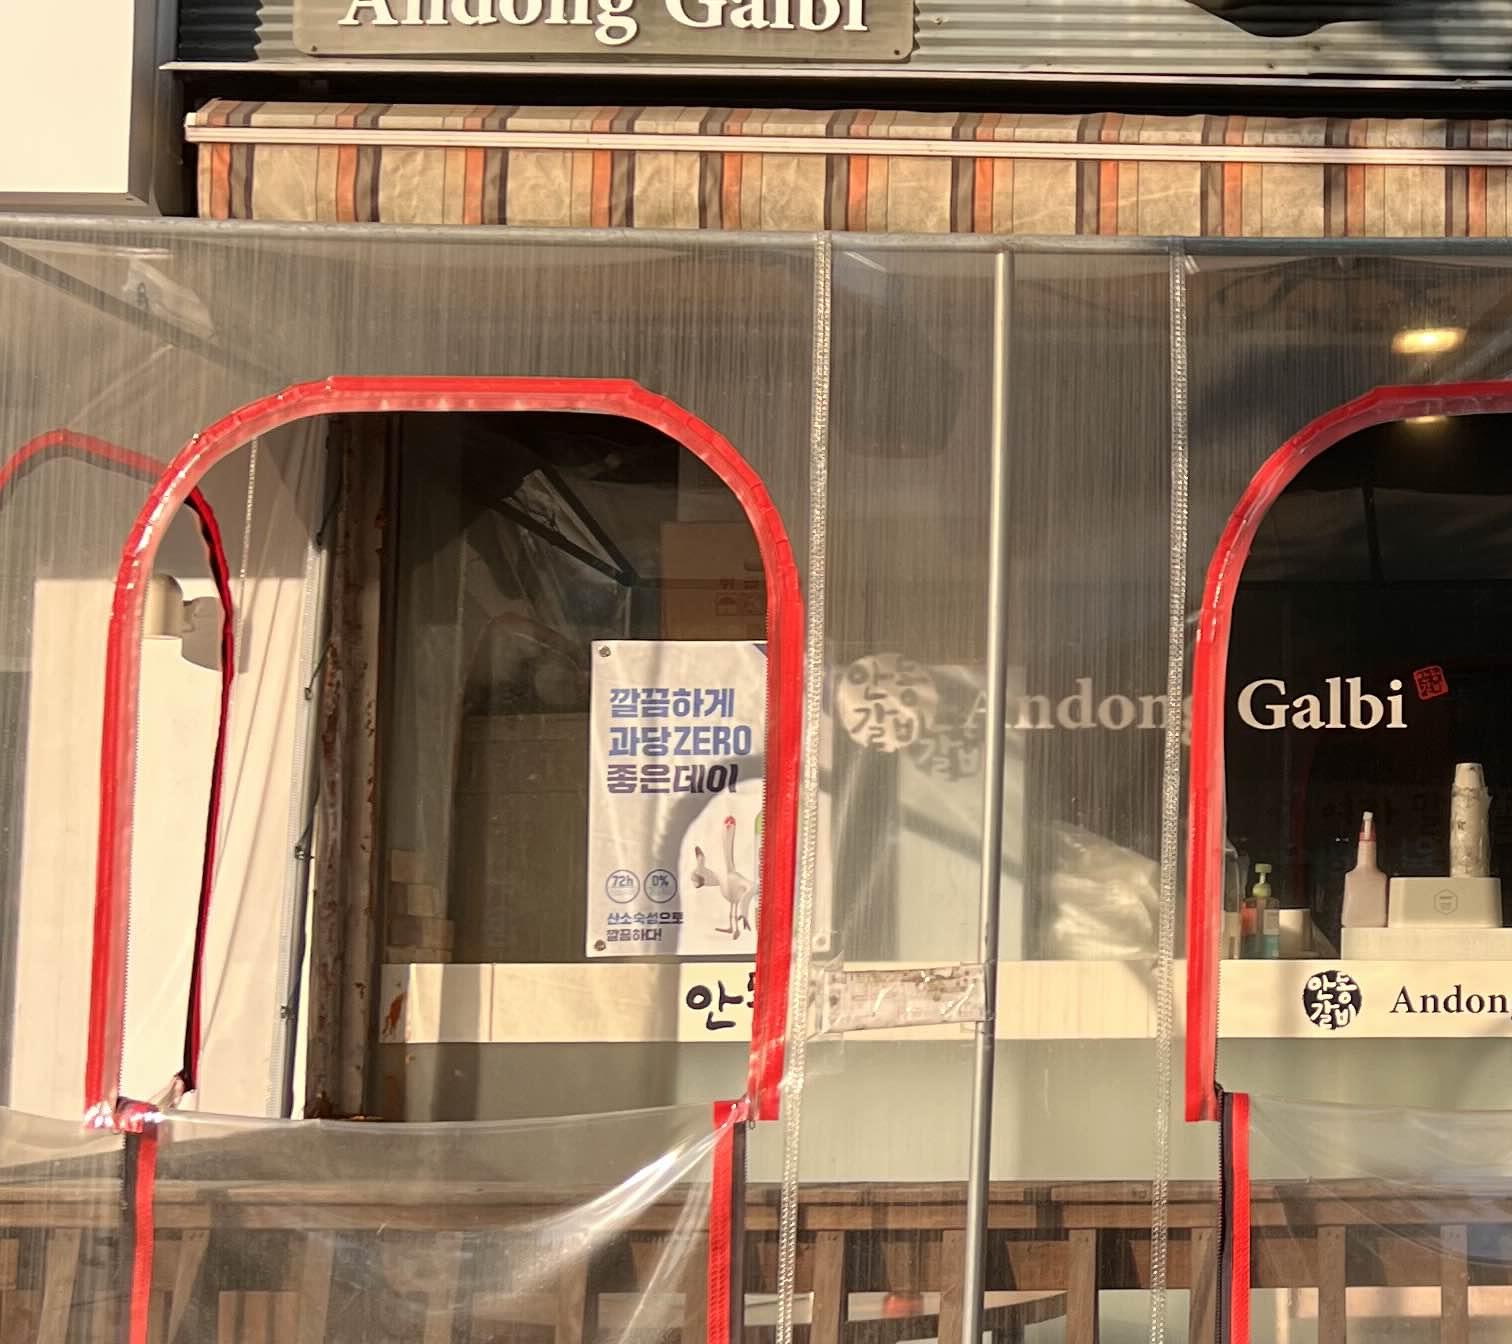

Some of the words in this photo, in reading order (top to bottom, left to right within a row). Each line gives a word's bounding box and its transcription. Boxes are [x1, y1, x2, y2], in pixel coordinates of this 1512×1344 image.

[610, 687, 735, 718] 깔끔하게
[1237, 676, 1408, 730] Galbi
[612, 875, 633, 888] 72h
[686, 972, 756, 1030] 안
